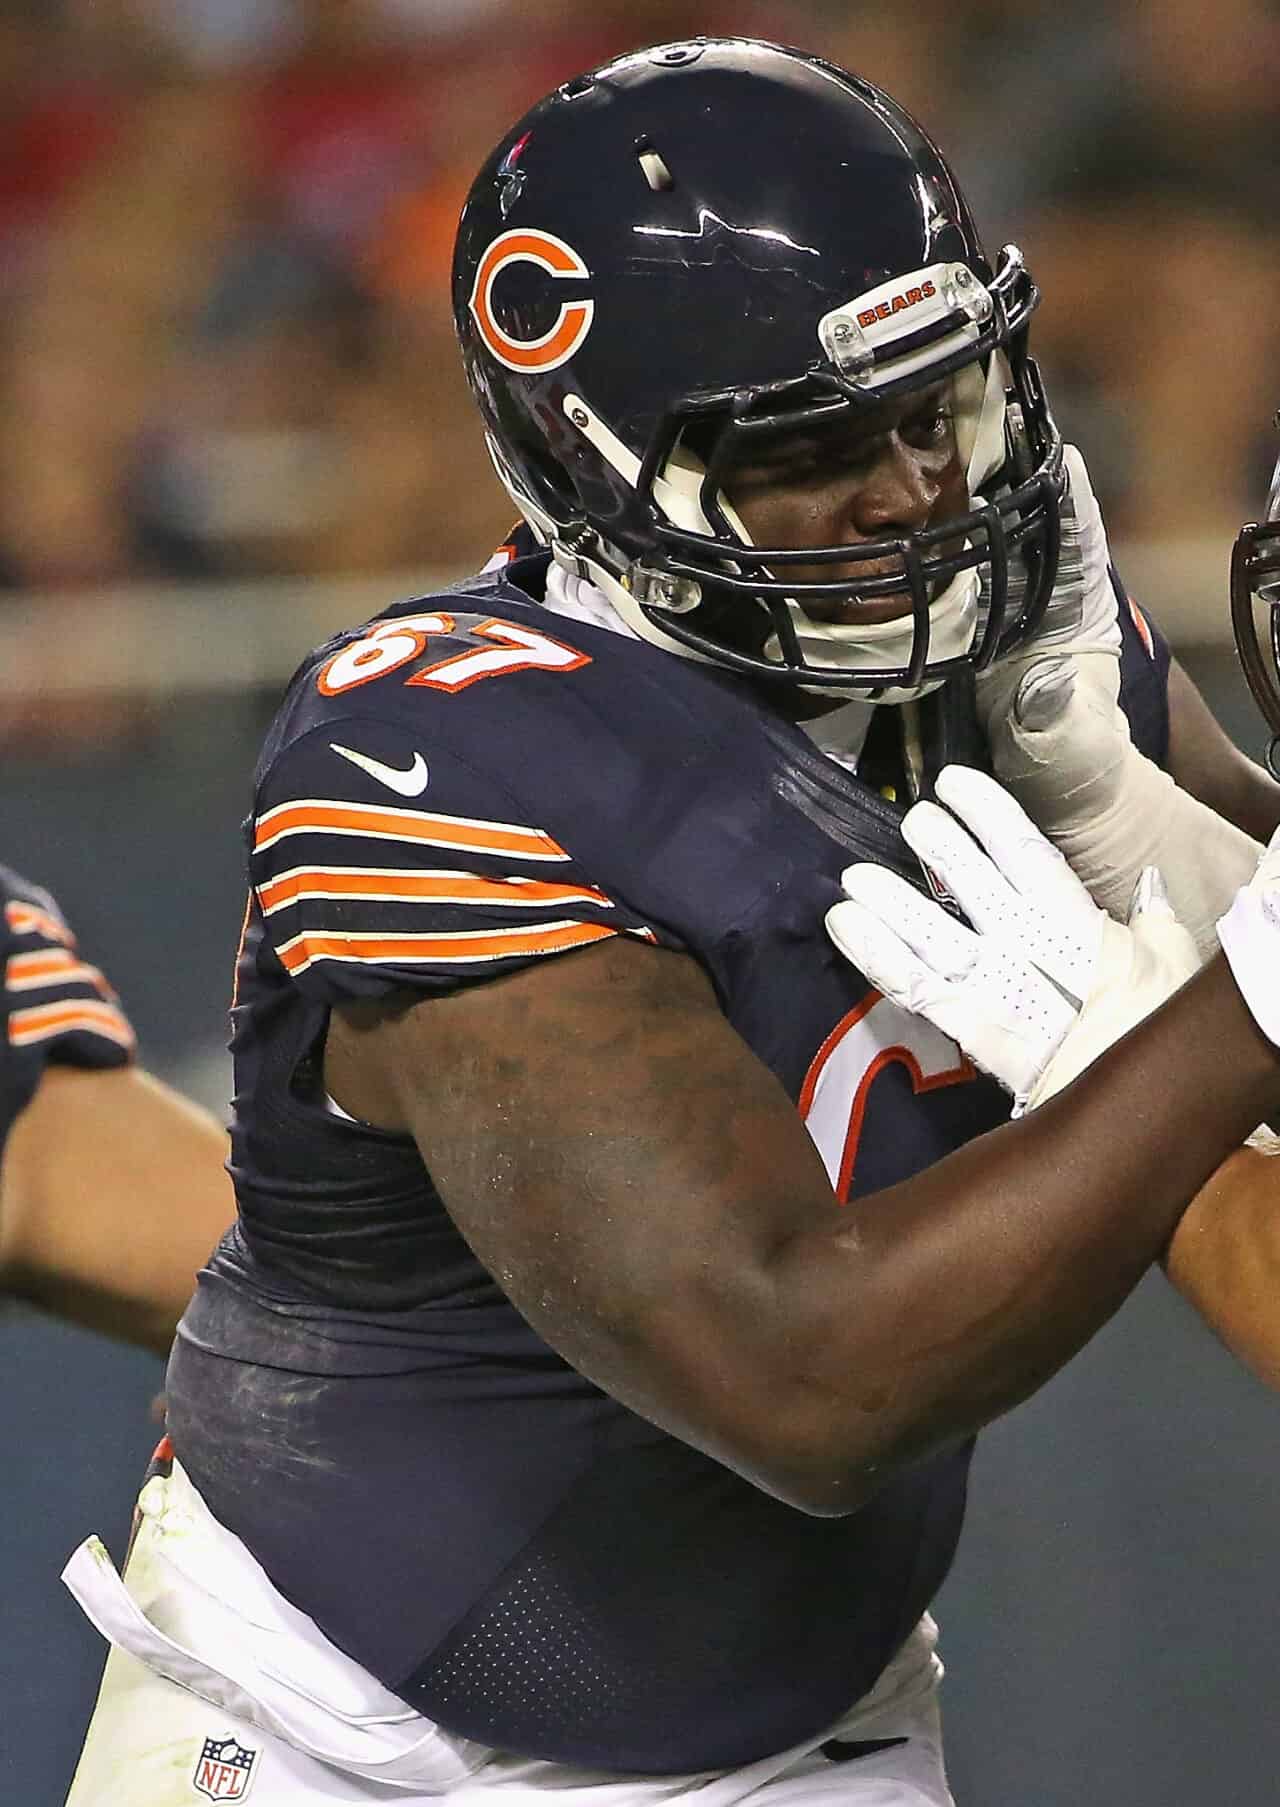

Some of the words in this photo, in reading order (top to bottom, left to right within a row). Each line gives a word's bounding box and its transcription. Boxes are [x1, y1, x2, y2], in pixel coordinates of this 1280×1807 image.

[468, 228, 594, 374] C
[856, 280, 936, 328] BEARS
[316, 611, 594, 696] 67
[199, 1761, 241, 1794] NFL
